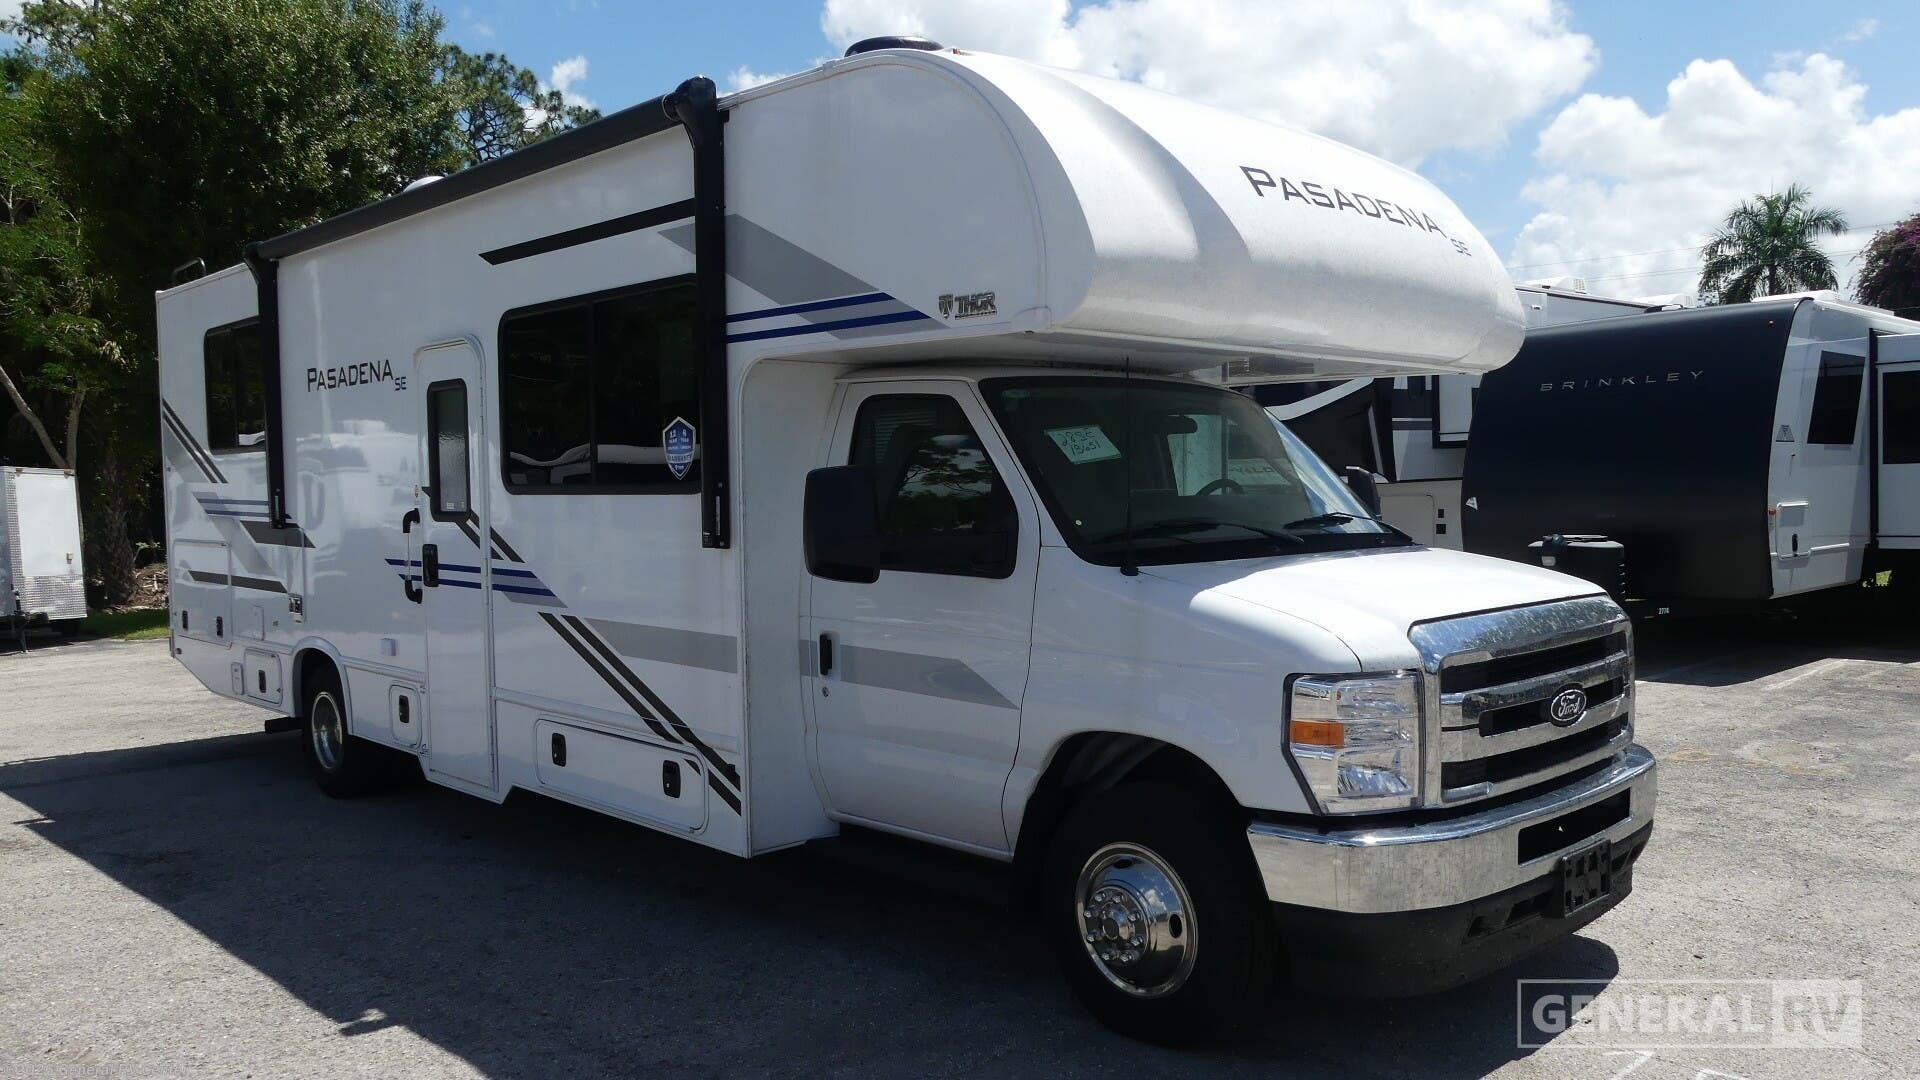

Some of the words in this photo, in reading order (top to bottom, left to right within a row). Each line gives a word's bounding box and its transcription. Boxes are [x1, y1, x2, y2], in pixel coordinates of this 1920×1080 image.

[1239, 165, 1447, 238] PASADENA
[1450, 237, 1472, 257] SE
[954, 291, 996, 314] THOR
[306, 359, 394, 393] PASADENA
[394, 376, 407, 391] SE
[1539, 370, 1704, 392] BRINKLEY
[1558, 694, 1581, 717] Ford
